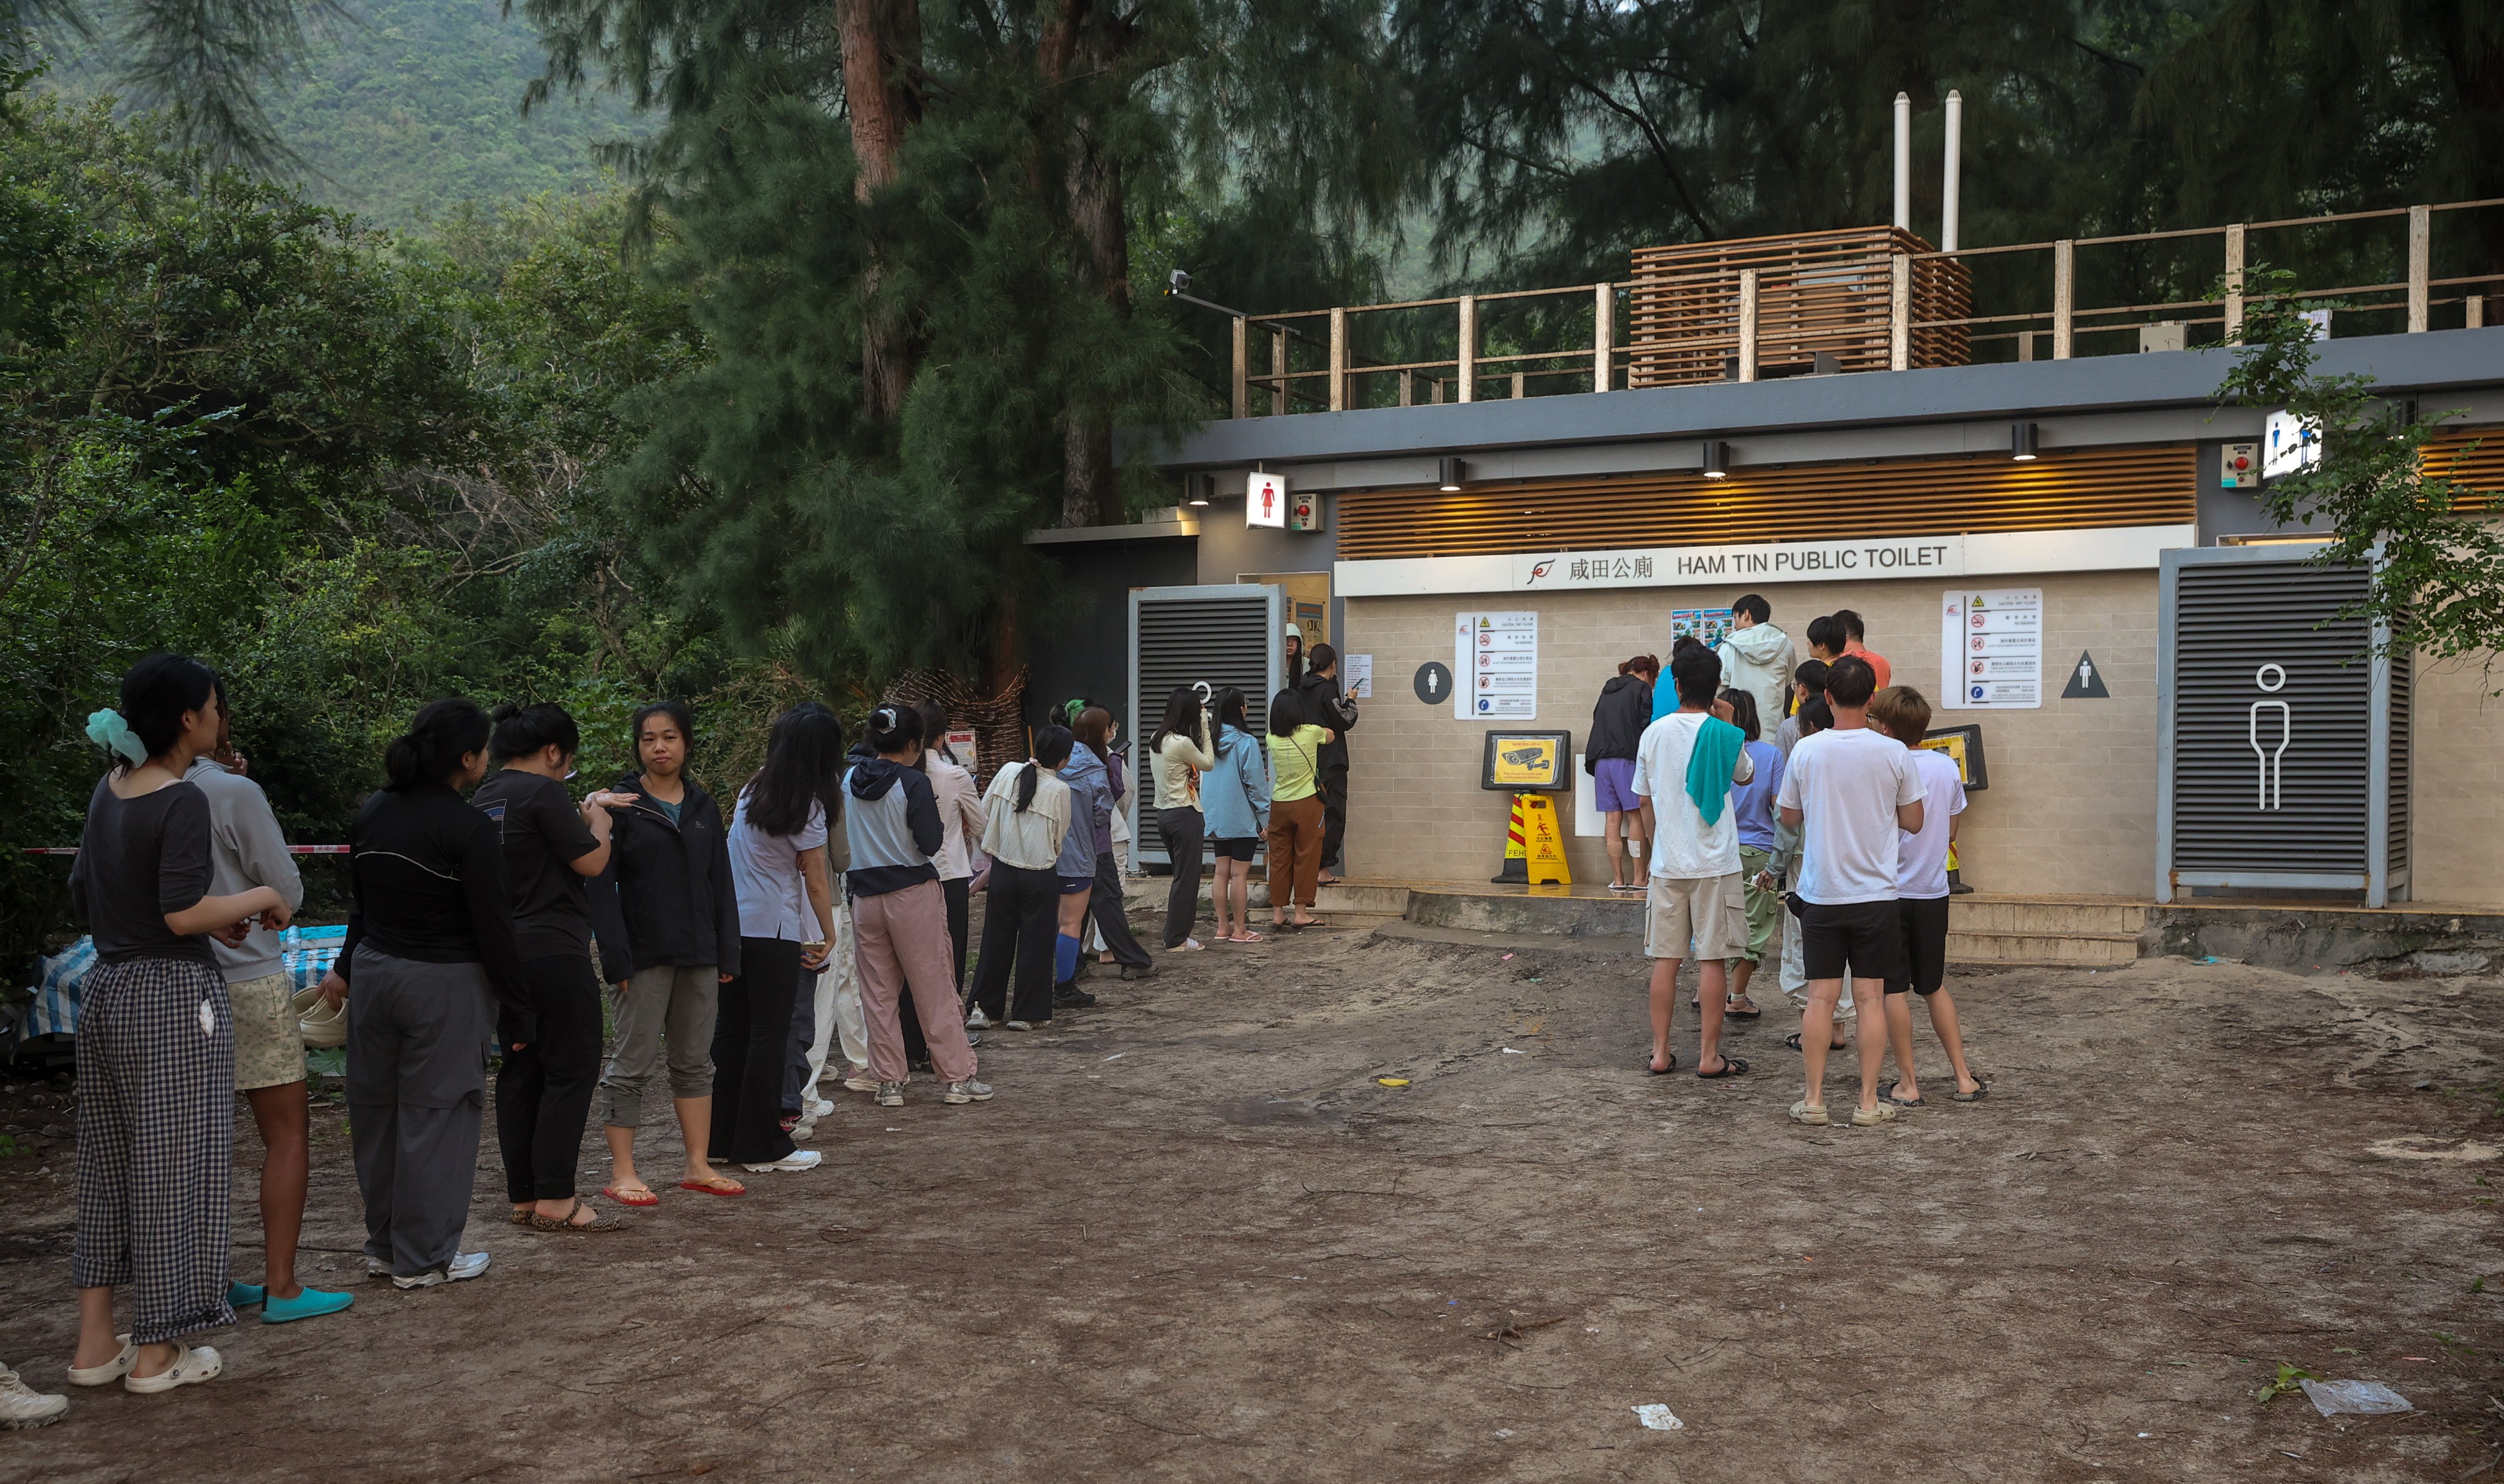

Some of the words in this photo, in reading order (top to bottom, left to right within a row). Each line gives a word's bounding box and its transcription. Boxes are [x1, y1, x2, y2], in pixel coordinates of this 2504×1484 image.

[1569, 555, 1653, 581] 咸田公廁
[1678, 555, 1725, 575] HAM
[1732, 553, 1767, 573] TIN
[1775, 549, 1857, 571] PUBLIC
[1865, 546, 1948, 568] TOILET
